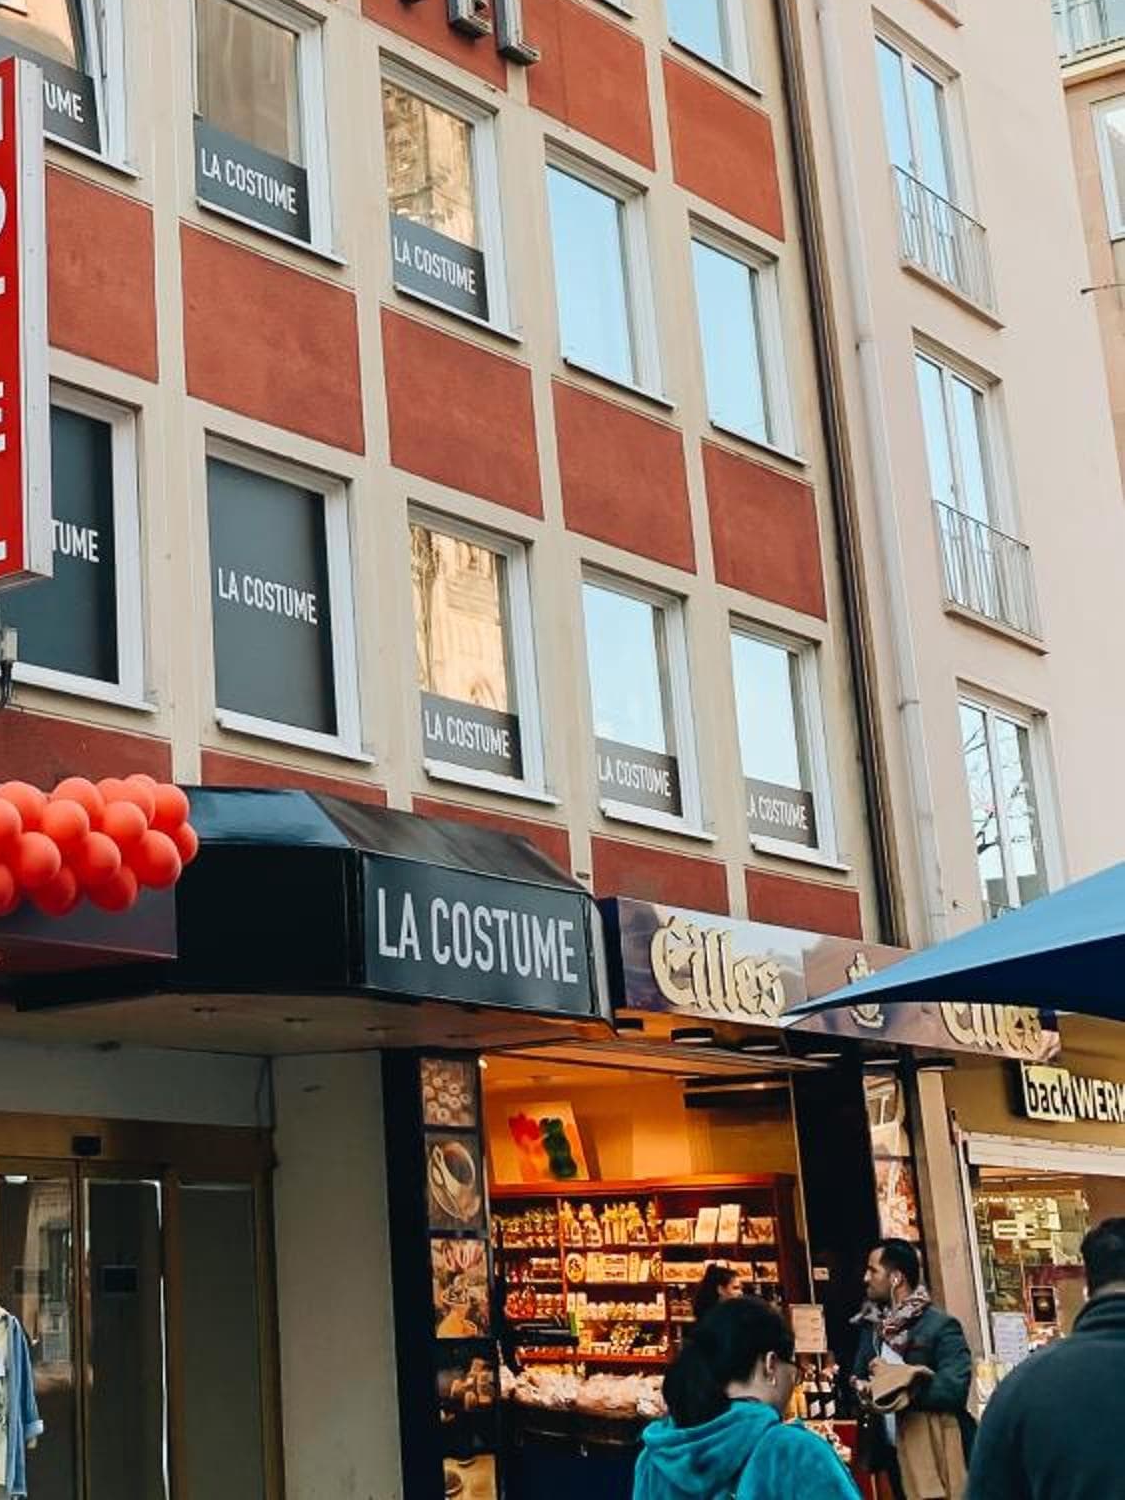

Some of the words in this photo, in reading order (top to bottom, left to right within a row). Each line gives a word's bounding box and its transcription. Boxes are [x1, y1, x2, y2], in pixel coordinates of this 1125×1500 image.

[200, 148, 223, 182] LA
[226, 157, 298, 216] COSTUME
[393, 235, 412, 268] LA
[413, 245, 477, 296] COSTUME
[51, 518, 100, 563] TUME
[217, 566, 240, 602] LA
[242, 575, 318, 625] COSTUME
[425, 709, 444, 742] LA
[445, 717, 512, 759] COSTUME
[597, 754, 615, 784] LA
[615, 758, 672, 797] COSTUME
[758, 795, 809, 831] COSTUME
[377, 887, 423, 961] LA
[430, 897, 579, 984] COSTUME
